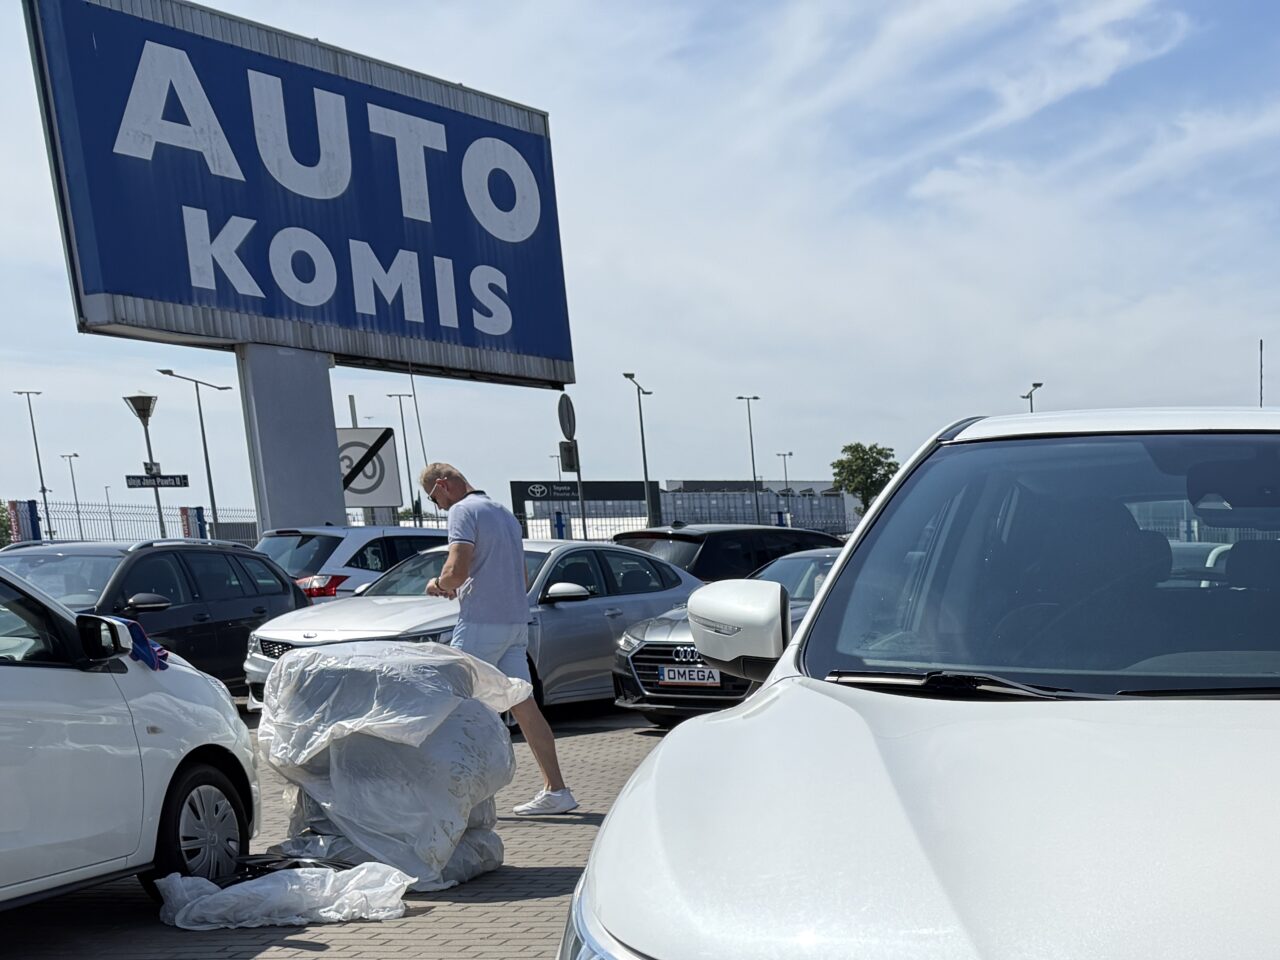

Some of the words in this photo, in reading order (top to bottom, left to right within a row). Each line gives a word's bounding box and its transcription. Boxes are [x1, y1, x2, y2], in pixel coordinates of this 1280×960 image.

[113, 39, 541, 243] AUTO
[182, 204, 513, 336] KOMIS
[667, 669, 716, 682] OMEGA
